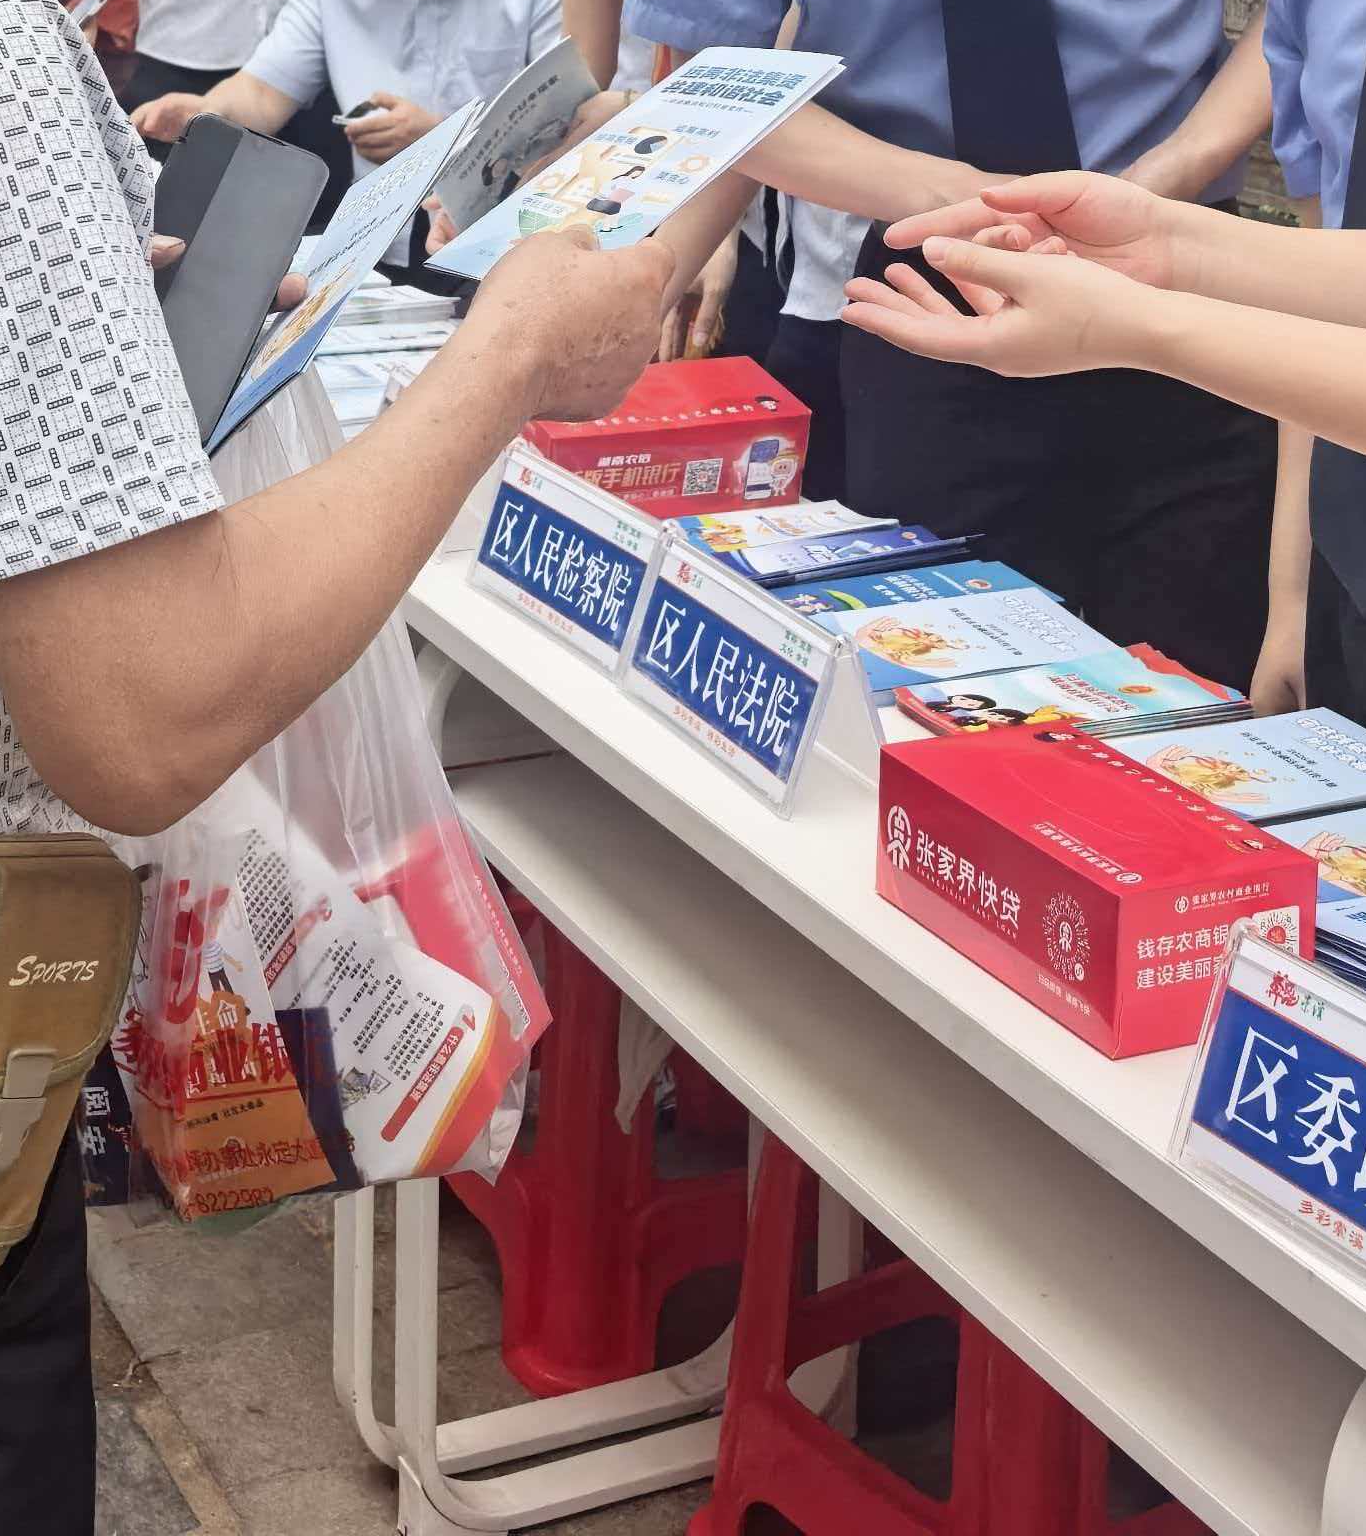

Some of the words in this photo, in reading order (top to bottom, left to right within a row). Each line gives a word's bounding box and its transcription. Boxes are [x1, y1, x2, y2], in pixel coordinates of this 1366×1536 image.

[575, 463, 682, 489] 版手机银行
[490, 500, 632, 632] 区人民检察院
[646, 600, 799, 757] 区人民法院
[916, 829, 1022, 930] 张家界快贷
